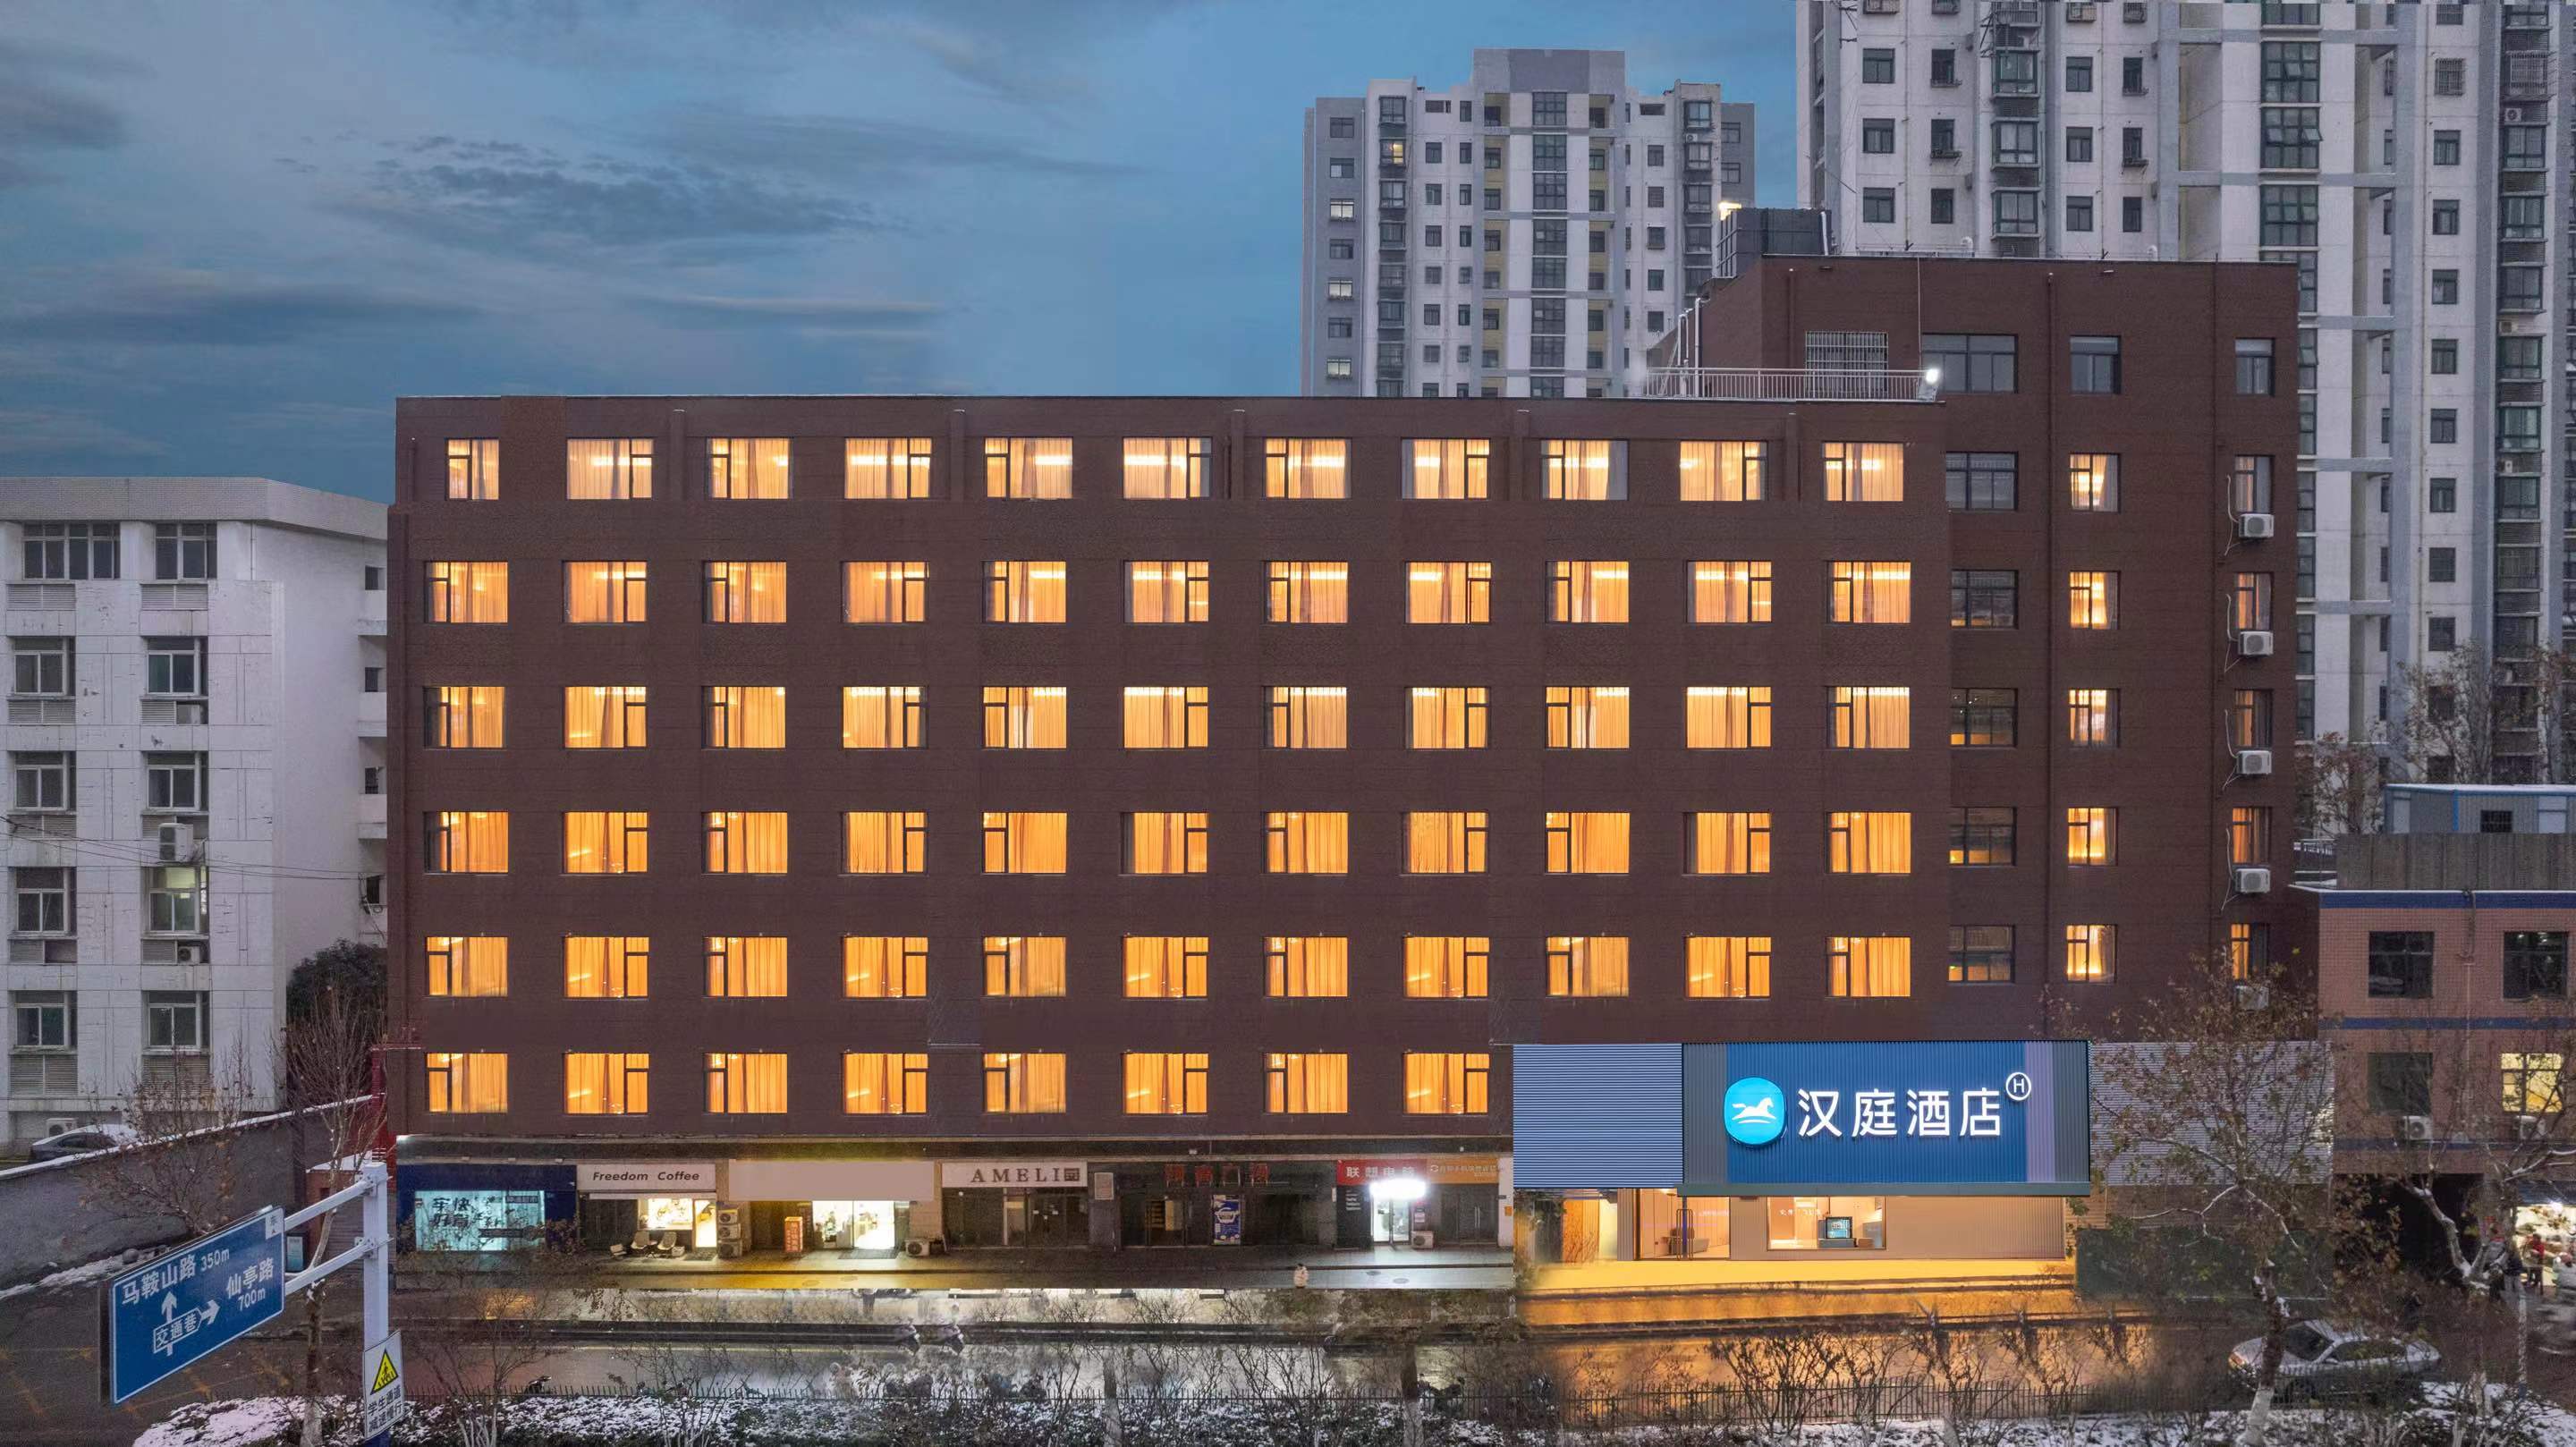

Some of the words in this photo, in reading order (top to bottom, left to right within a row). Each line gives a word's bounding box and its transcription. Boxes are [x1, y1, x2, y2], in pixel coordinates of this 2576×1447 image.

[1798, 1087, 2001, 1138] 汉庭酒店
[592, 1171, 648, 1181] Freedom
[657, 1171, 700, 1181] Coffee
[970, 1167, 1060, 1182] AMELI
[122, 1255, 196, 1305] 马鞍山路
[200, 1248, 230, 1272] 350m
[226, 1257, 274, 1299] 仙亭路
[238, 1288, 266, 1312] 700m
[156, 1313, 198, 1348] 交通巷
